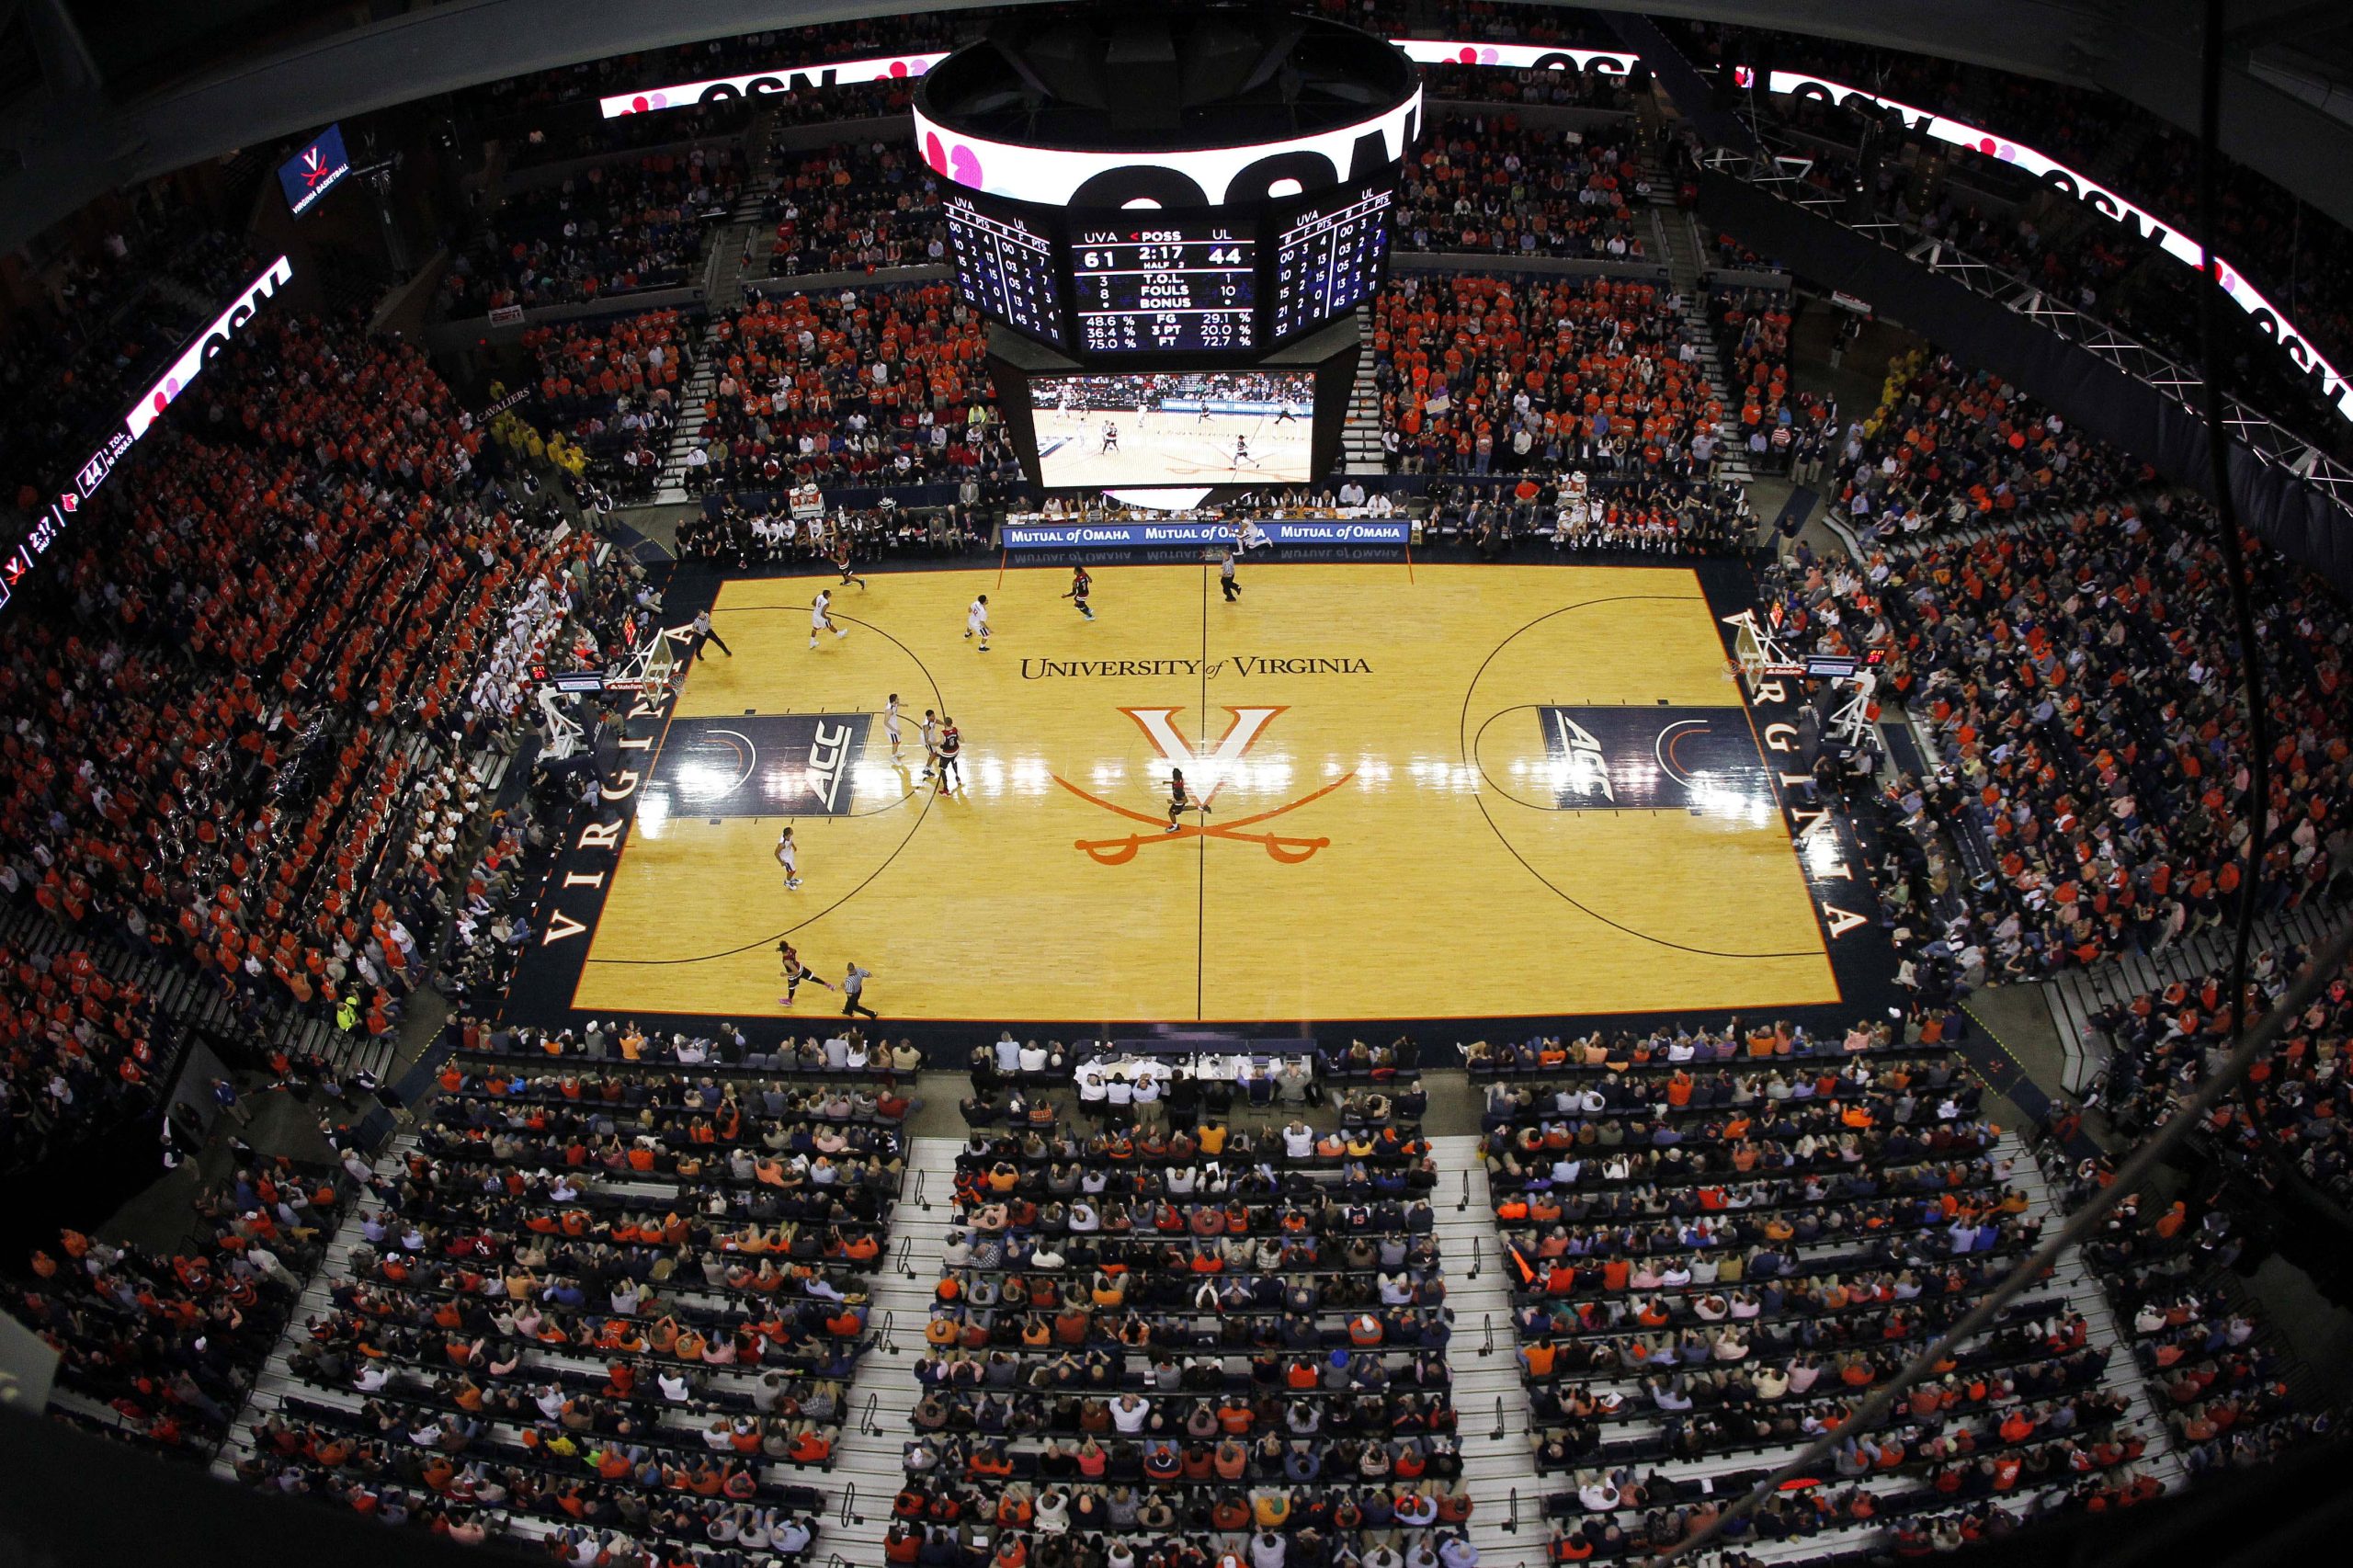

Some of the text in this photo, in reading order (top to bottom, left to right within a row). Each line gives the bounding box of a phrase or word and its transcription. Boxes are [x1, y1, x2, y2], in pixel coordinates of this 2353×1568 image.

[291, 163, 349, 214] VIRGINIA BASKETBALL
[1362, 188, 1374, 200] UL
[954, 196, 974, 212] UVA
[1013, 218, 1027, 232] UL
[1296, 210, 1319, 226] UVA
[1340, 211, 1384, 238] 00 3 7
[949, 222, 989, 245] 00 3 4
[1084, 229, 1232, 243] UVA POSS UL
[1339, 229, 1381, 256] 03 2 7
[954, 239, 994, 263] 10 2 13
[1002, 242, 1045, 267] 00 3 7
[1084, 246, 1241, 268] 61 2:17 44
[1280, 235, 1327, 264] 00 3 4
[1337, 246, 1379, 273] 05 4 3
[958, 256, 998, 280] 15 2 15
[1006, 260, 1048, 285] 03 2 7
[1100, 273, 1231, 287] 3 T.O.L. 1
[1281, 253, 1327, 282] 10 2 13
[1337, 264, 1377, 290] 13 3 4
[962, 273, 1000, 296] 21 2 0
[1009, 278, 1051, 303] 05 4 3
[1100, 285, 1236, 299] 8 FOULS 10
[1280, 271, 1325, 299] 15 2 15
[1333, 280, 1375, 307] 45 2 11
[964, 289, 1003, 314] 32 1 8
[1014, 295, 1054, 321] 13 3 4
[1140, 298, 1191, 309] BONUS
[1278, 290, 1322, 318] 21 2 0
[1016, 313, 1058, 340] 45 2 11
[1086, 313, 1251, 327] 48.6 % FG 29.1 %
[1087, 325, 1251, 338] 36.4 % 3 PT 20.0 %
[1276, 307, 1320, 337] 32 1 8
[1088, 336, 1251, 349] 75.0 % FT 72.7 %
[477, 387, 530, 422] CAVALIERS
[114, 435, 133, 459] FOULS
[85, 460, 102, 486] 44
[29, 516, 51, 549] 2:17
[1012, 529, 1130, 543] MUTUAL of OMAHA
[1146, 528, 1198, 539] MUTUAL
[1201, 526, 1216, 540] of
[1281, 525, 1400, 540] MUTUAL of OMAHA
[1021, 656, 1373, 679] UNIVERSITY of VIRGINIA
[805, 720, 847, 808] ACC
[1557, 712, 1615, 802] ACC
